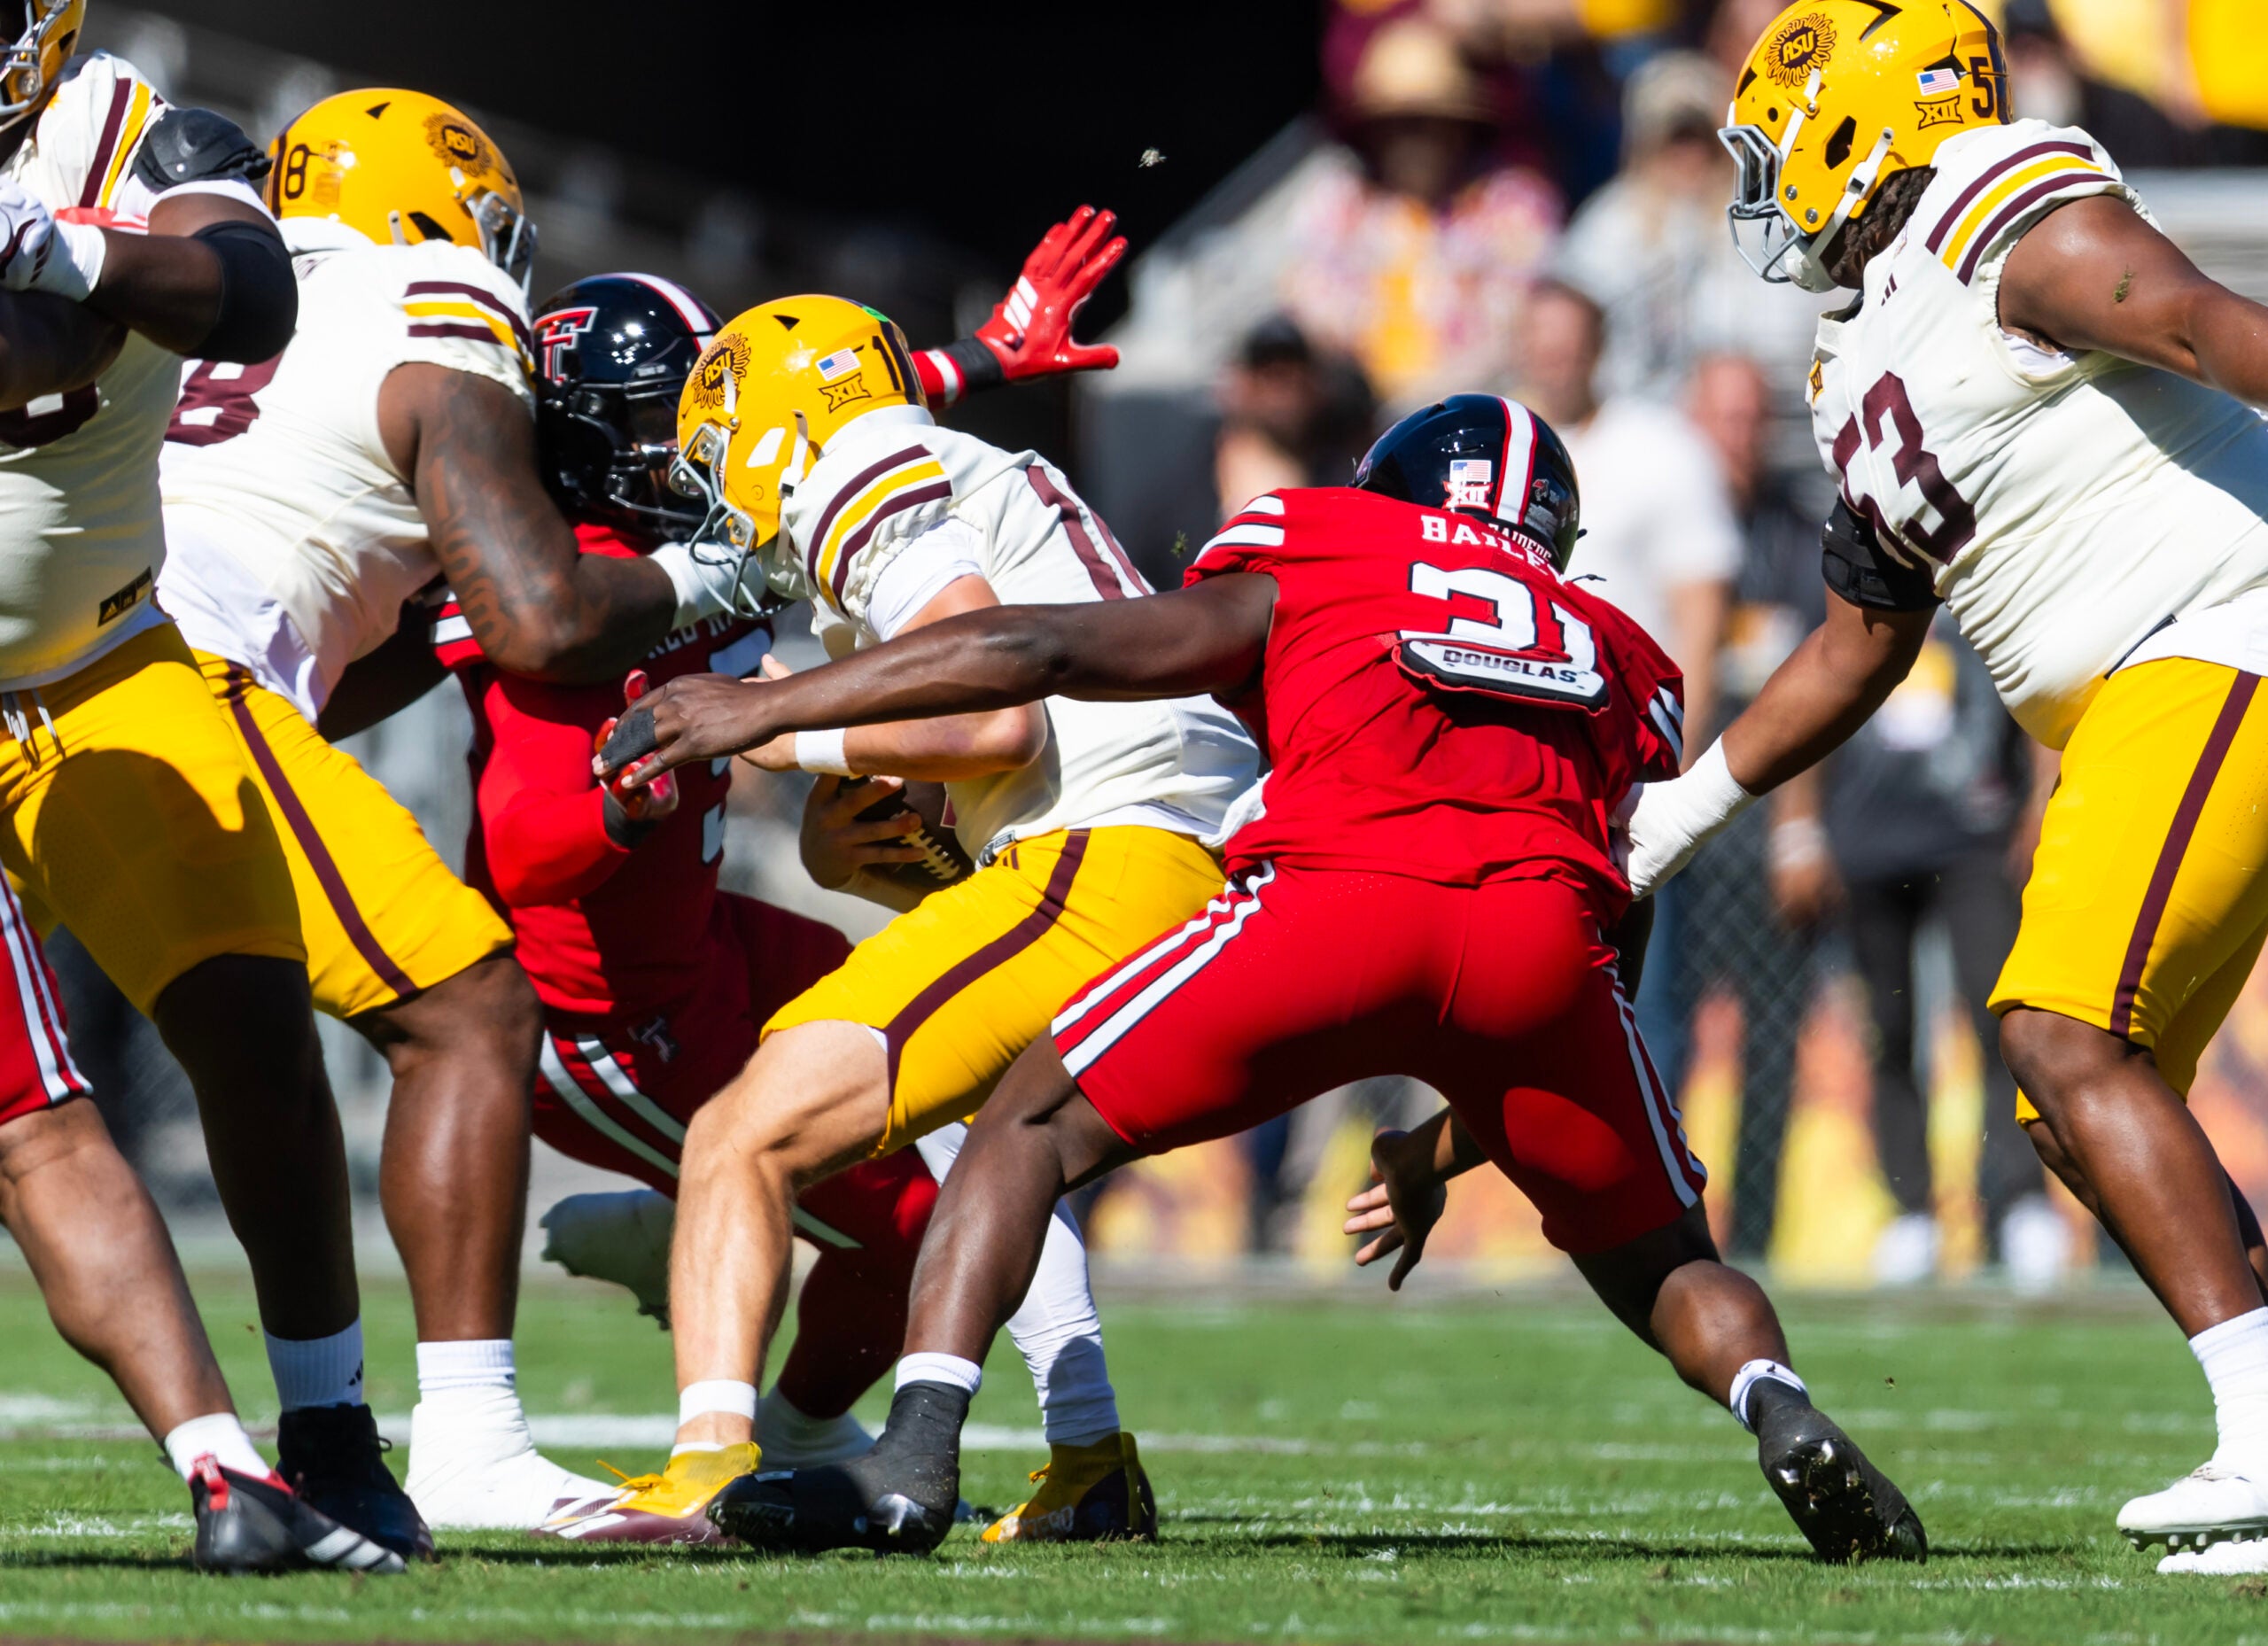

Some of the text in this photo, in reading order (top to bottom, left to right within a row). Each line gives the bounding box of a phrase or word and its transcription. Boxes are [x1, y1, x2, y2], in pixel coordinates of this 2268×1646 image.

[1783, 31, 1816, 64] ASU
[443, 127, 477, 156] ASU
[704, 351, 732, 388] ASU
[1442, 648, 1578, 684] DOUGLAS
